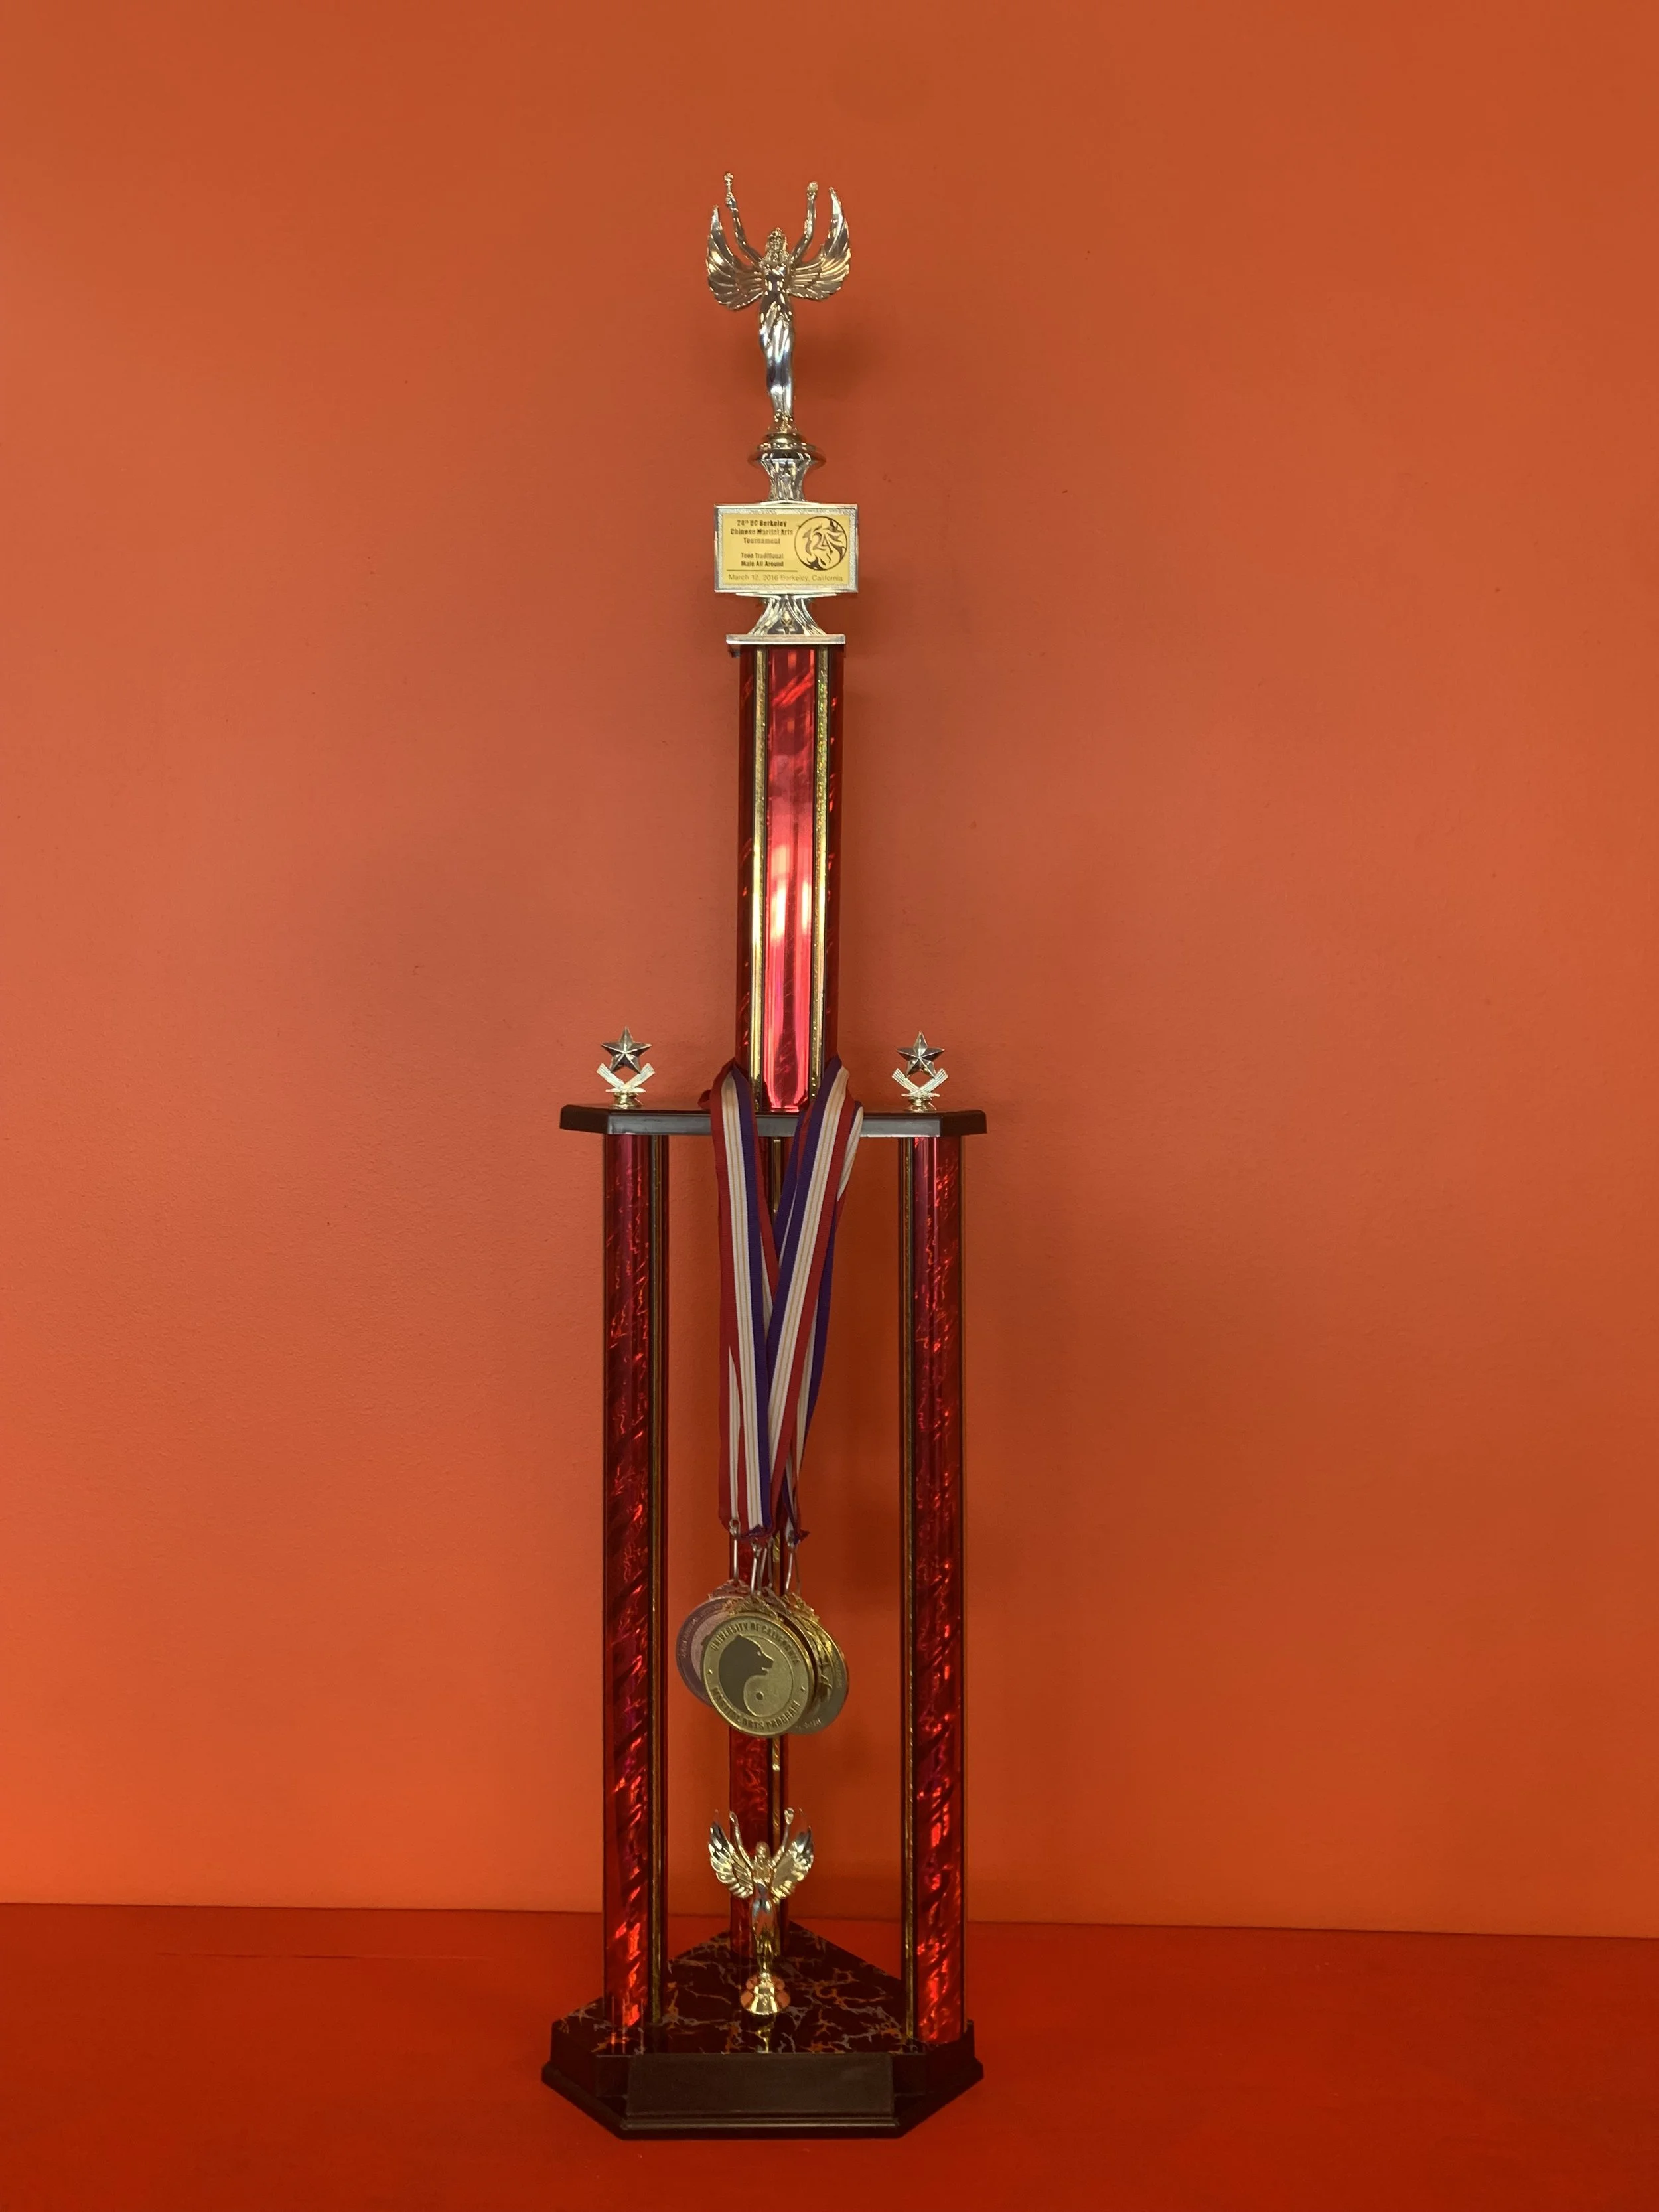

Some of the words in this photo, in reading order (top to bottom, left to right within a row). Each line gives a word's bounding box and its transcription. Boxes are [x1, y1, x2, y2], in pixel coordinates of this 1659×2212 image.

[711, 1622, 748, 1652] UNIVERSITY
[751, 1622, 760, 1632] OF
[762, 1625, 801, 1664] CALIFORNIA
[711, 1686, 741, 1722] MARTIAL
[743, 1717, 765, 1730] ARTS
[766, 1700, 800, 1730] PROGRAM
